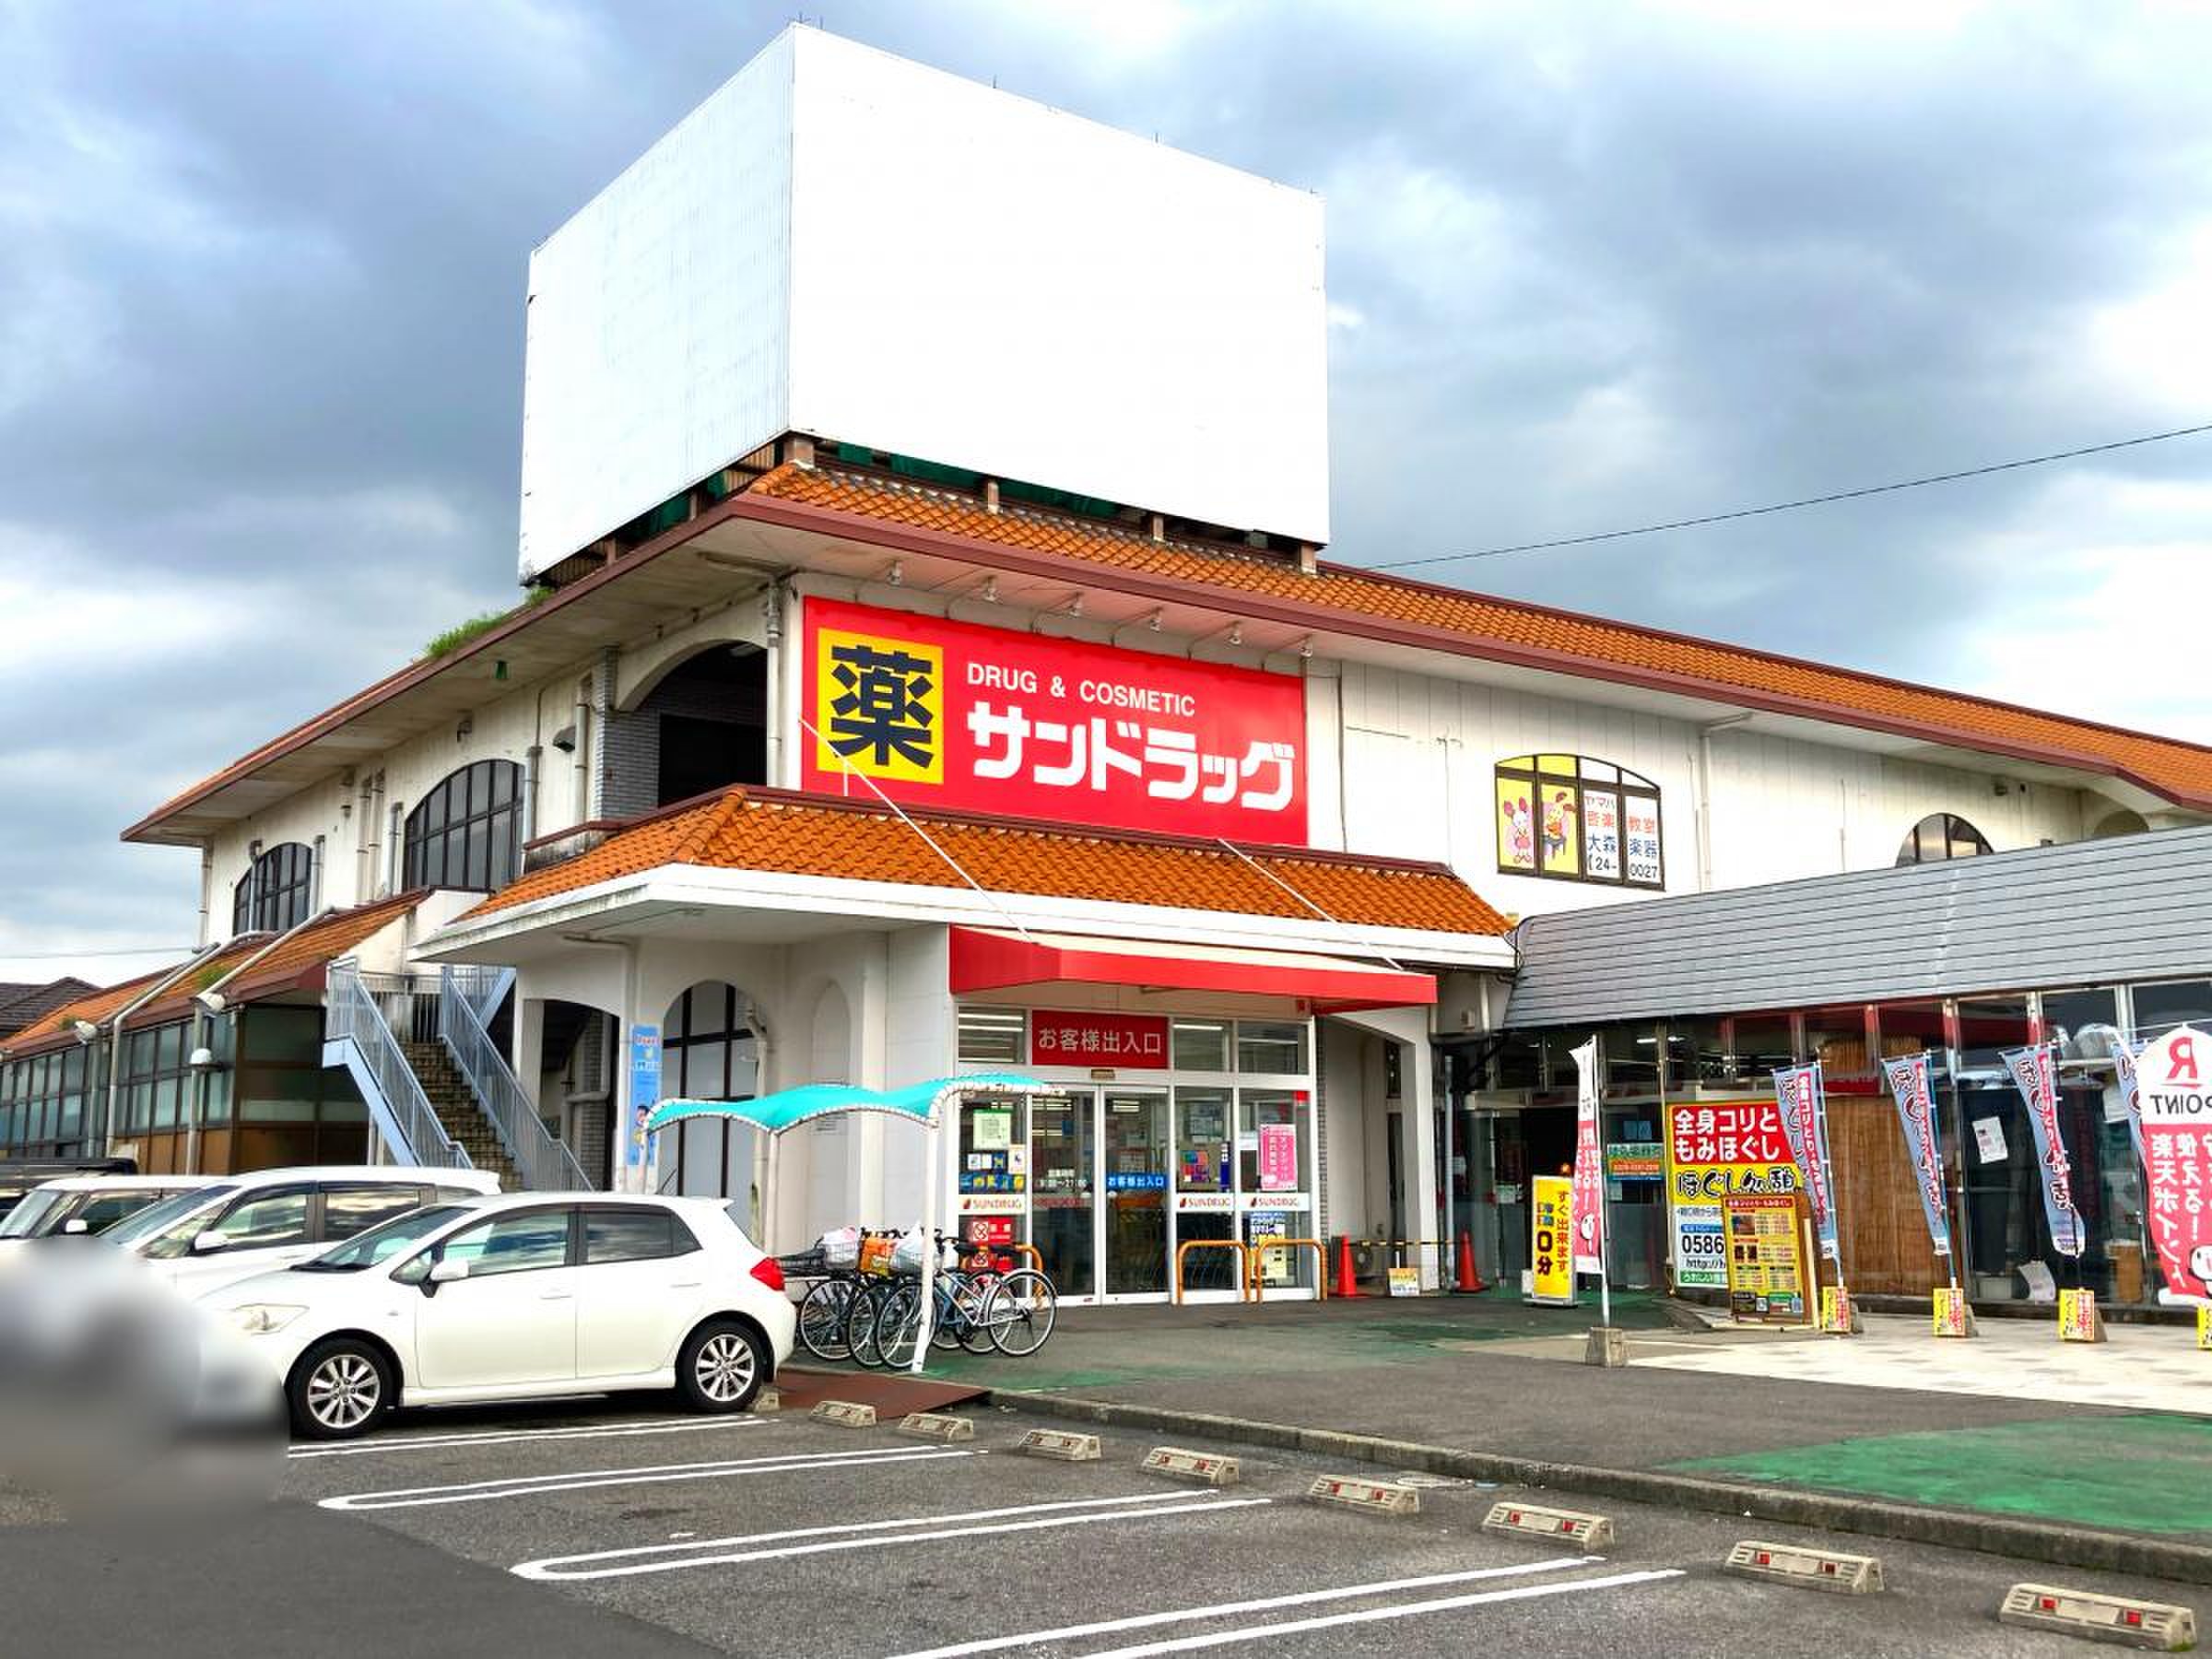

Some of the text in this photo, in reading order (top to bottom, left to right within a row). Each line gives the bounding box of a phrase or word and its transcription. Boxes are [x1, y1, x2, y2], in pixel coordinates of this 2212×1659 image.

[967, 663, 1196, 717] DRUG & COSMETIC
[831, 644, 934, 769] 薬
[967, 700, 1296, 812] サンドラッグ
[1038, 1028, 1162, 1055] お客様出入口
[1675, 1107, 1777, 1135] 全身コリと
[1675, 1135, 1780, 1163] もみほぐし
[1107, 1176, 1165, 1188] お客様出入口
[1188, 1197, 1231, 1207] SUNDRUG
[1681, 1234, 1724, 1254] 0586
